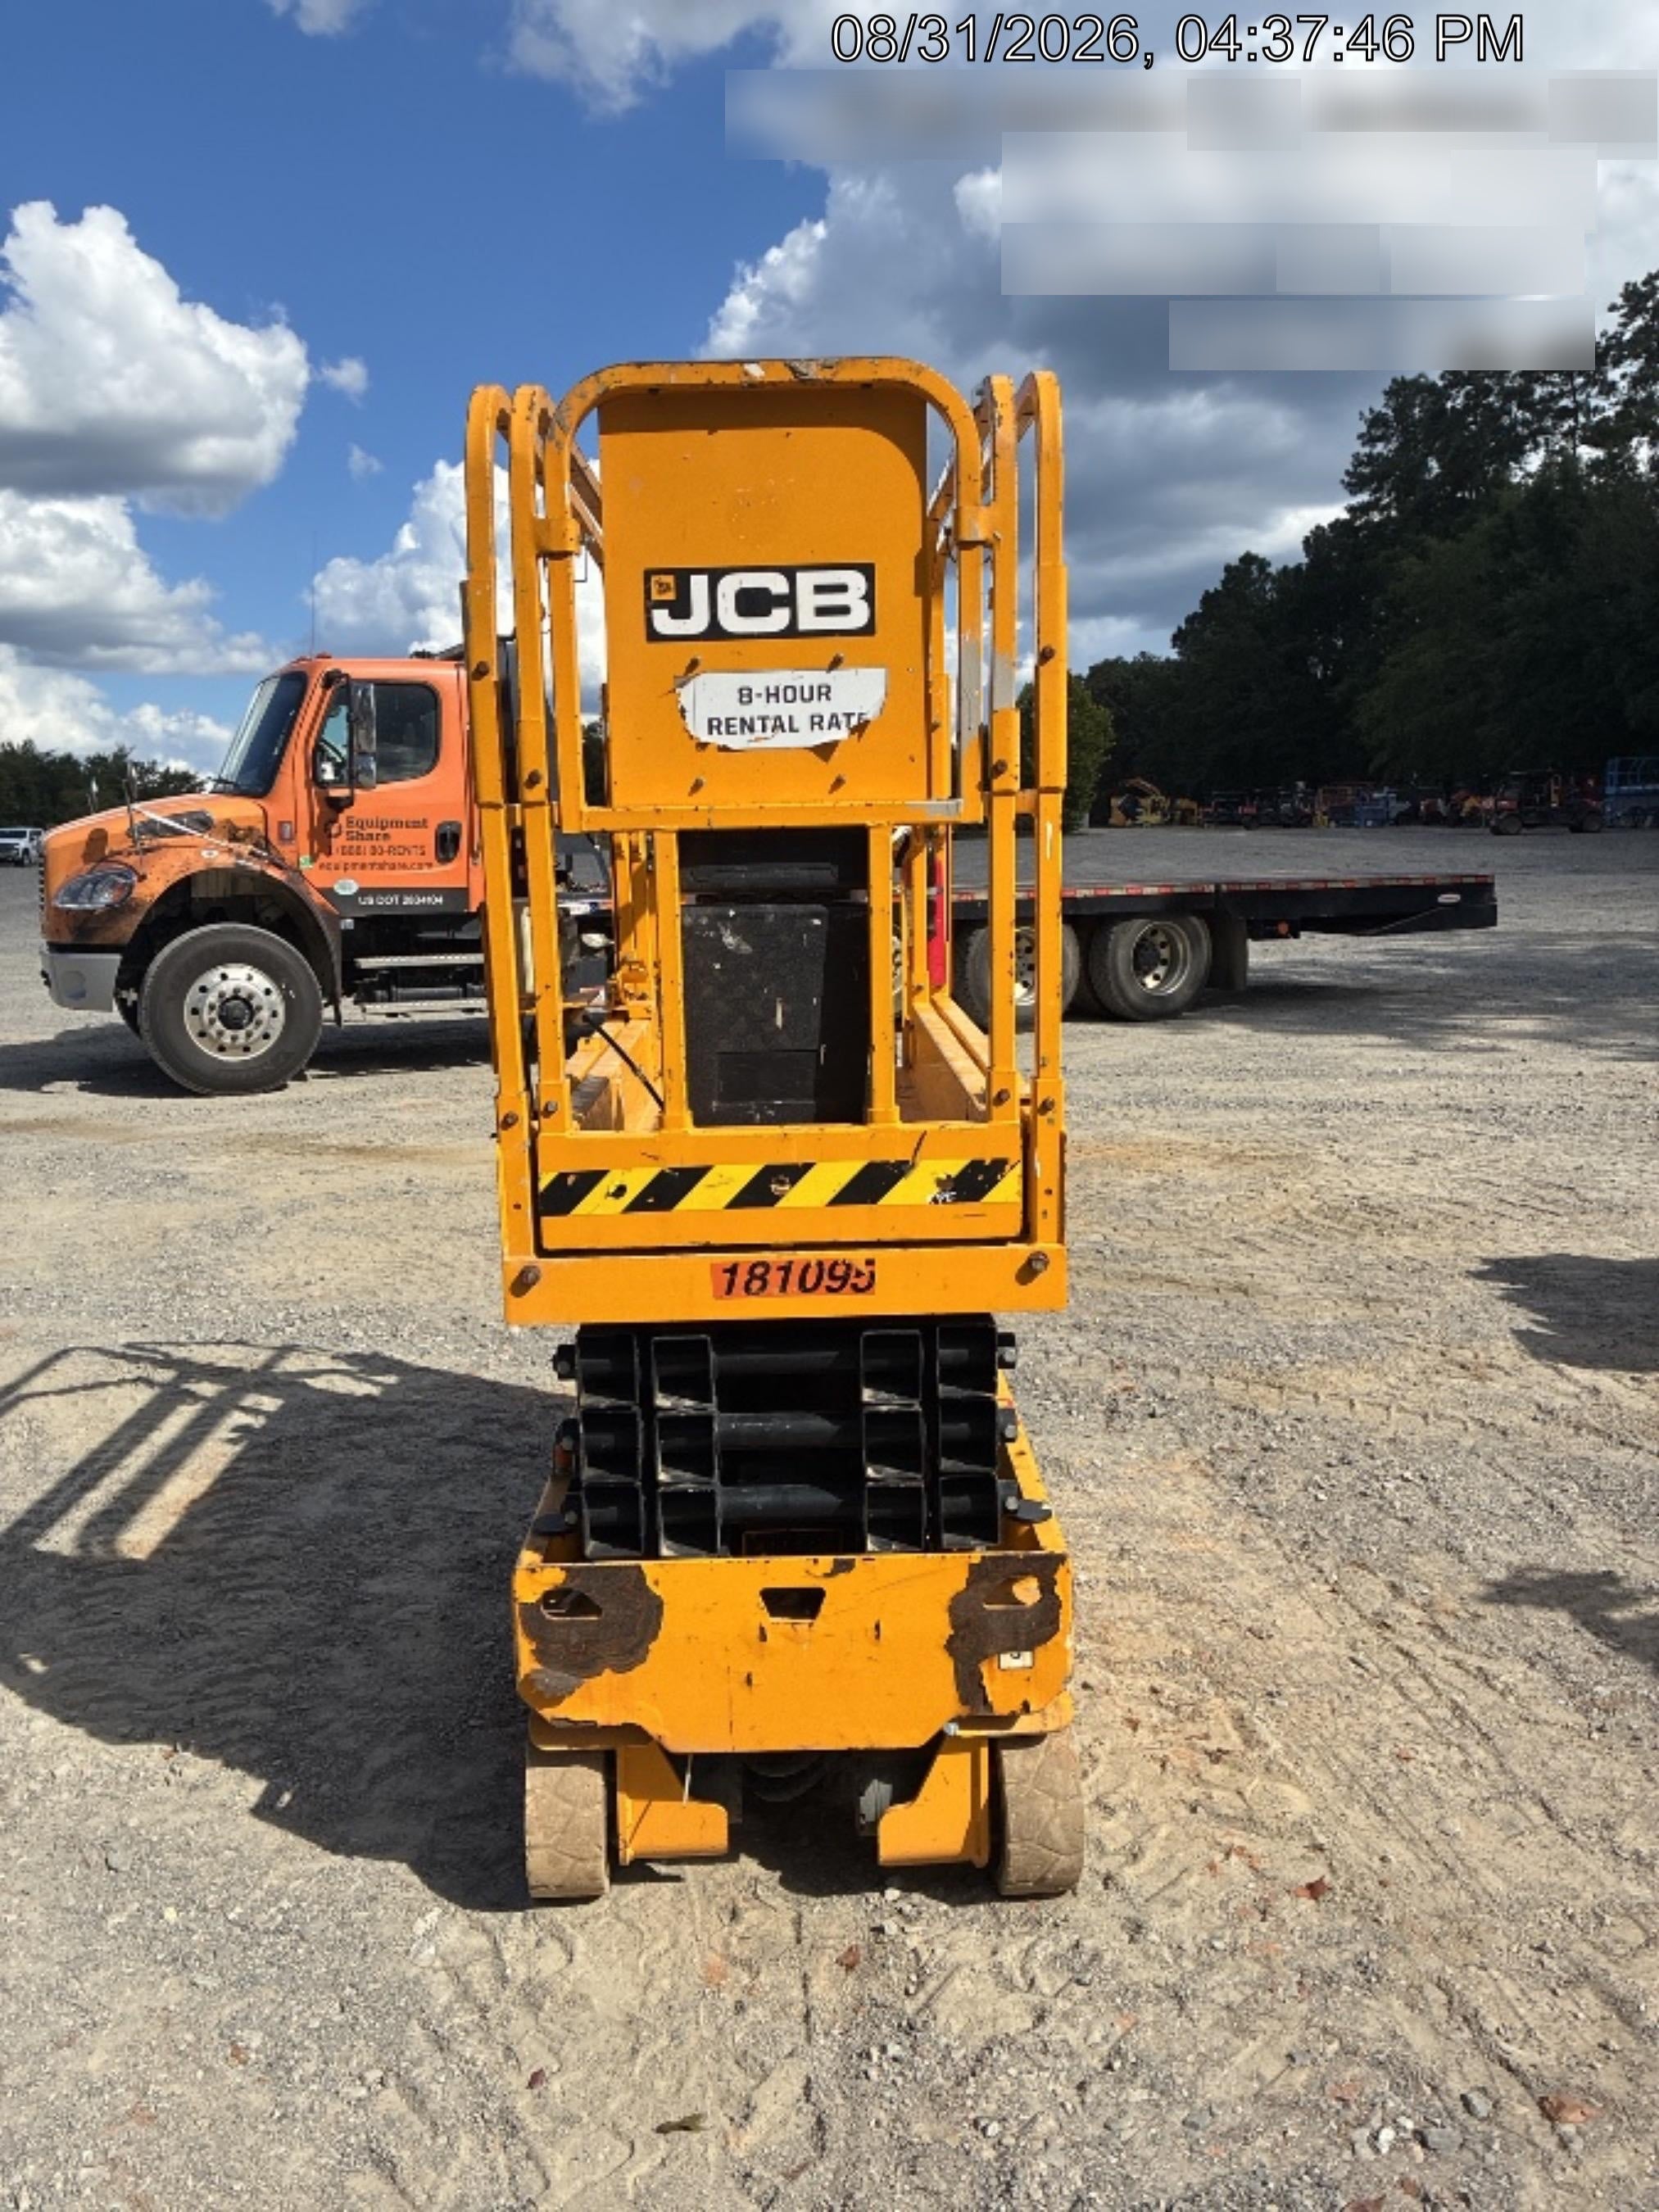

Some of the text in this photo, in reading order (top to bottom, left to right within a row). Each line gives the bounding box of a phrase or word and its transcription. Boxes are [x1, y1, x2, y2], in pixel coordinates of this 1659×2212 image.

[651, 569, 871, 636] JCB
[737, 683, 832, 706] 8-HOUR
[707, 714, 800, 736] RENTAL
[346, 817, 428, 831] Equipment
[346, 831, 391, 841] Share
[722, 1258, 876, 1296] 181095
